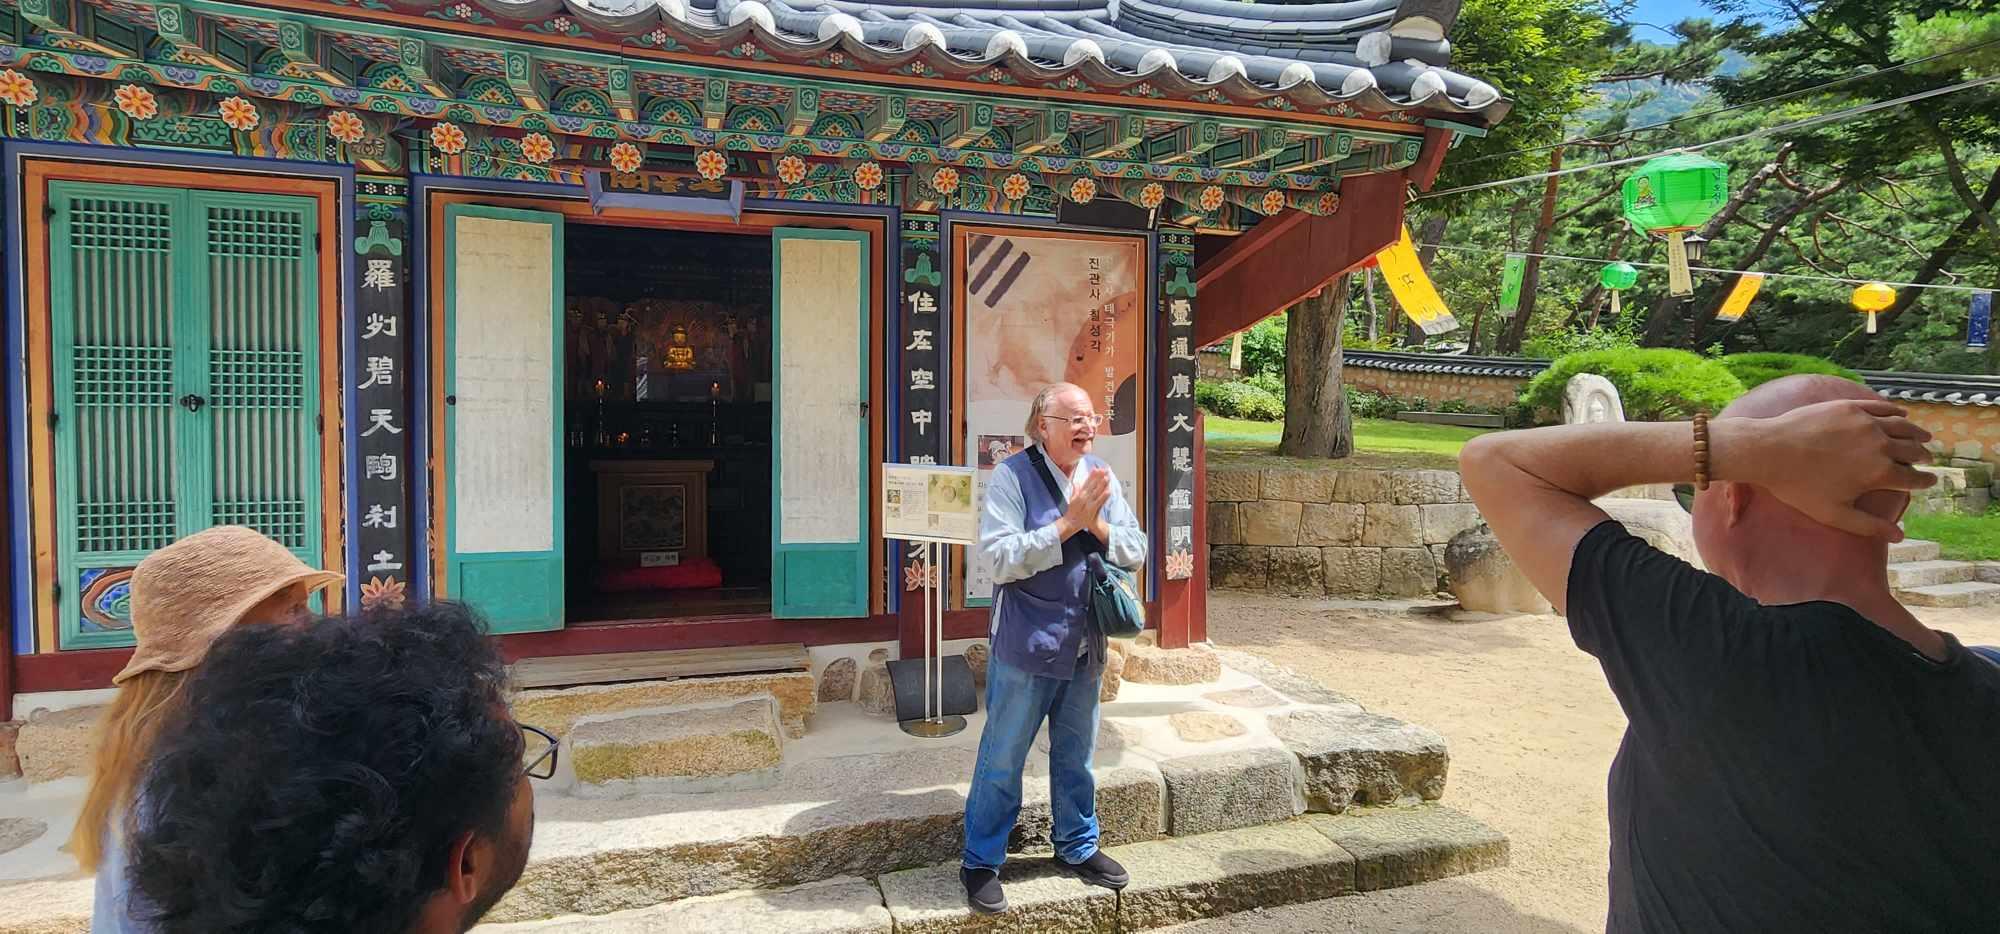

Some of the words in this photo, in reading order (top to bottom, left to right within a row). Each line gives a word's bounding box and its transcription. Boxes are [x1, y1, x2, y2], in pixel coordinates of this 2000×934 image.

[1089, 257, 1101, 301] 진관사
[1089, 309, 1101, 353] 칠성각
[1104, 303, 1115, 358] 태극기가
